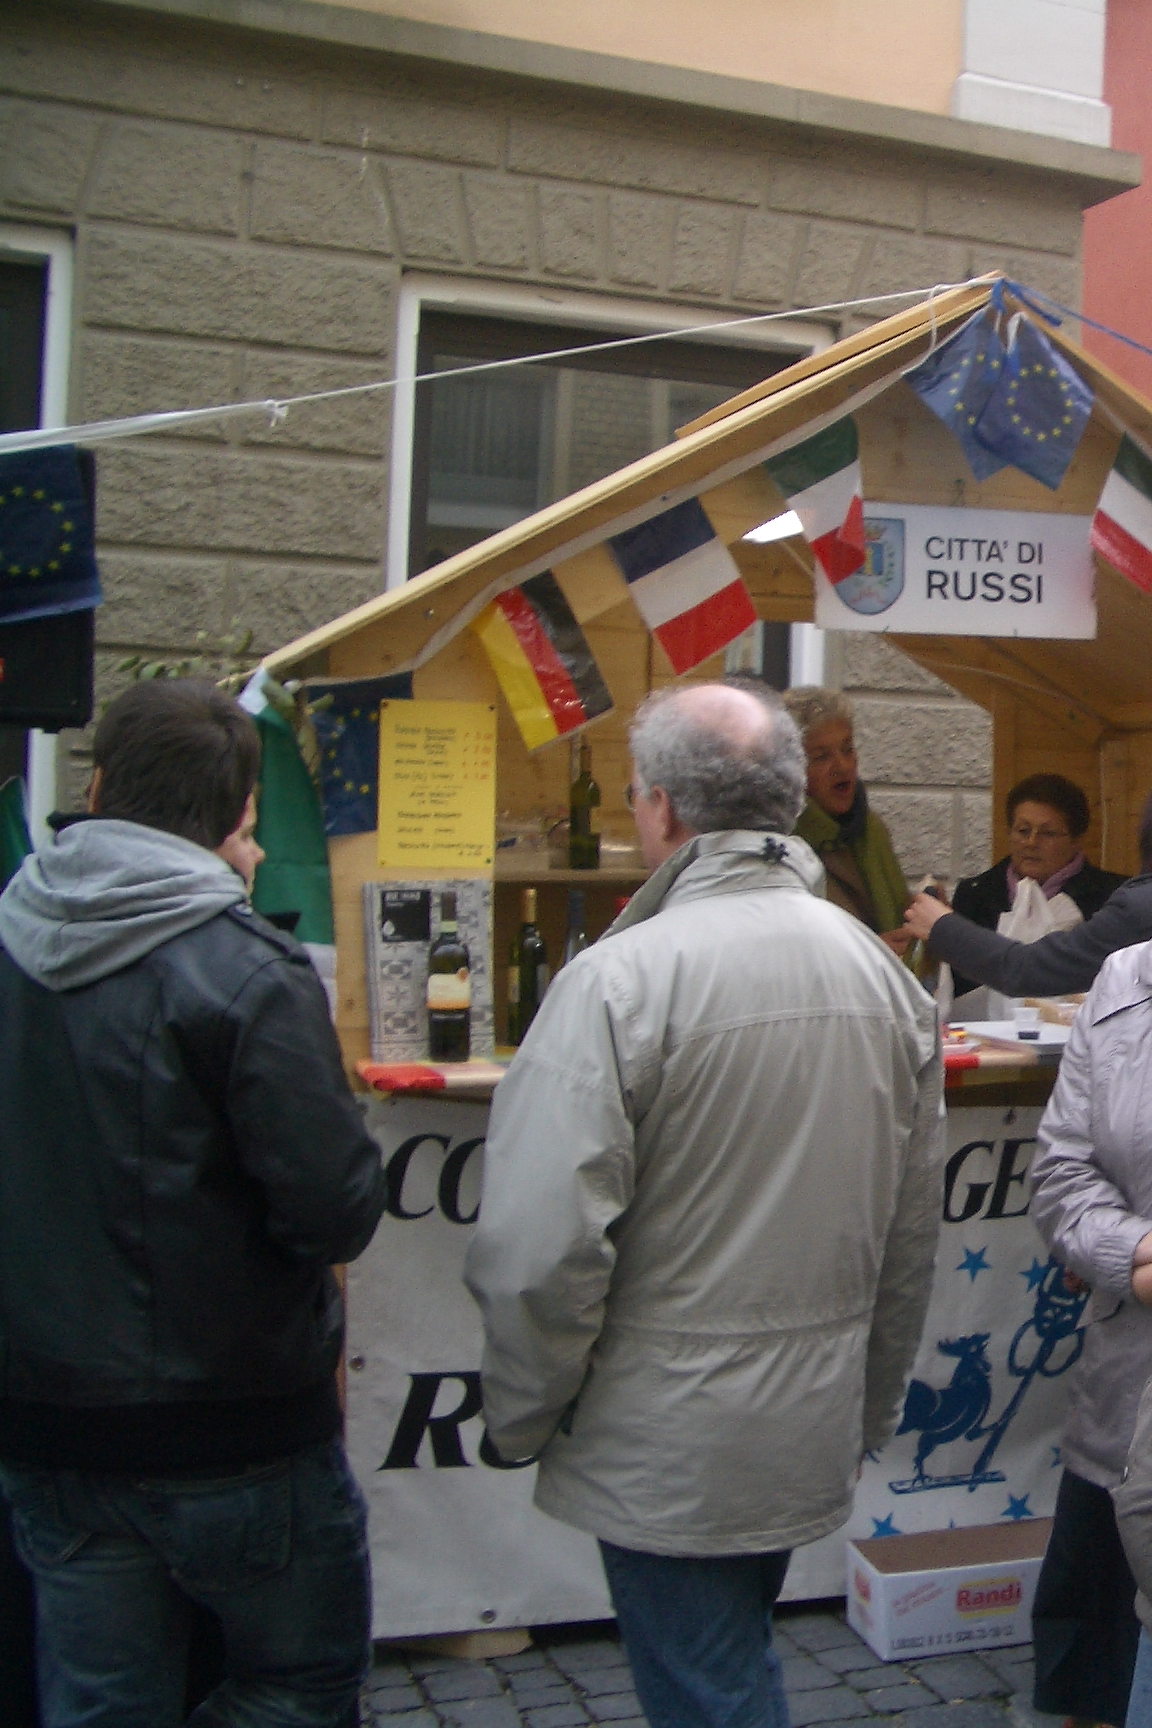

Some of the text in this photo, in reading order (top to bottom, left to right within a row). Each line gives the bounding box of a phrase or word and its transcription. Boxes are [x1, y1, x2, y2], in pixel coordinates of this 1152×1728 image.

[925, 536, 1043, 564] CITTA' DI
[926, 570, 1044, 604] RUSSI
[385, 1132, 1038, 1224] CO GE
[957, 1580, 1022, 1609] Randi
